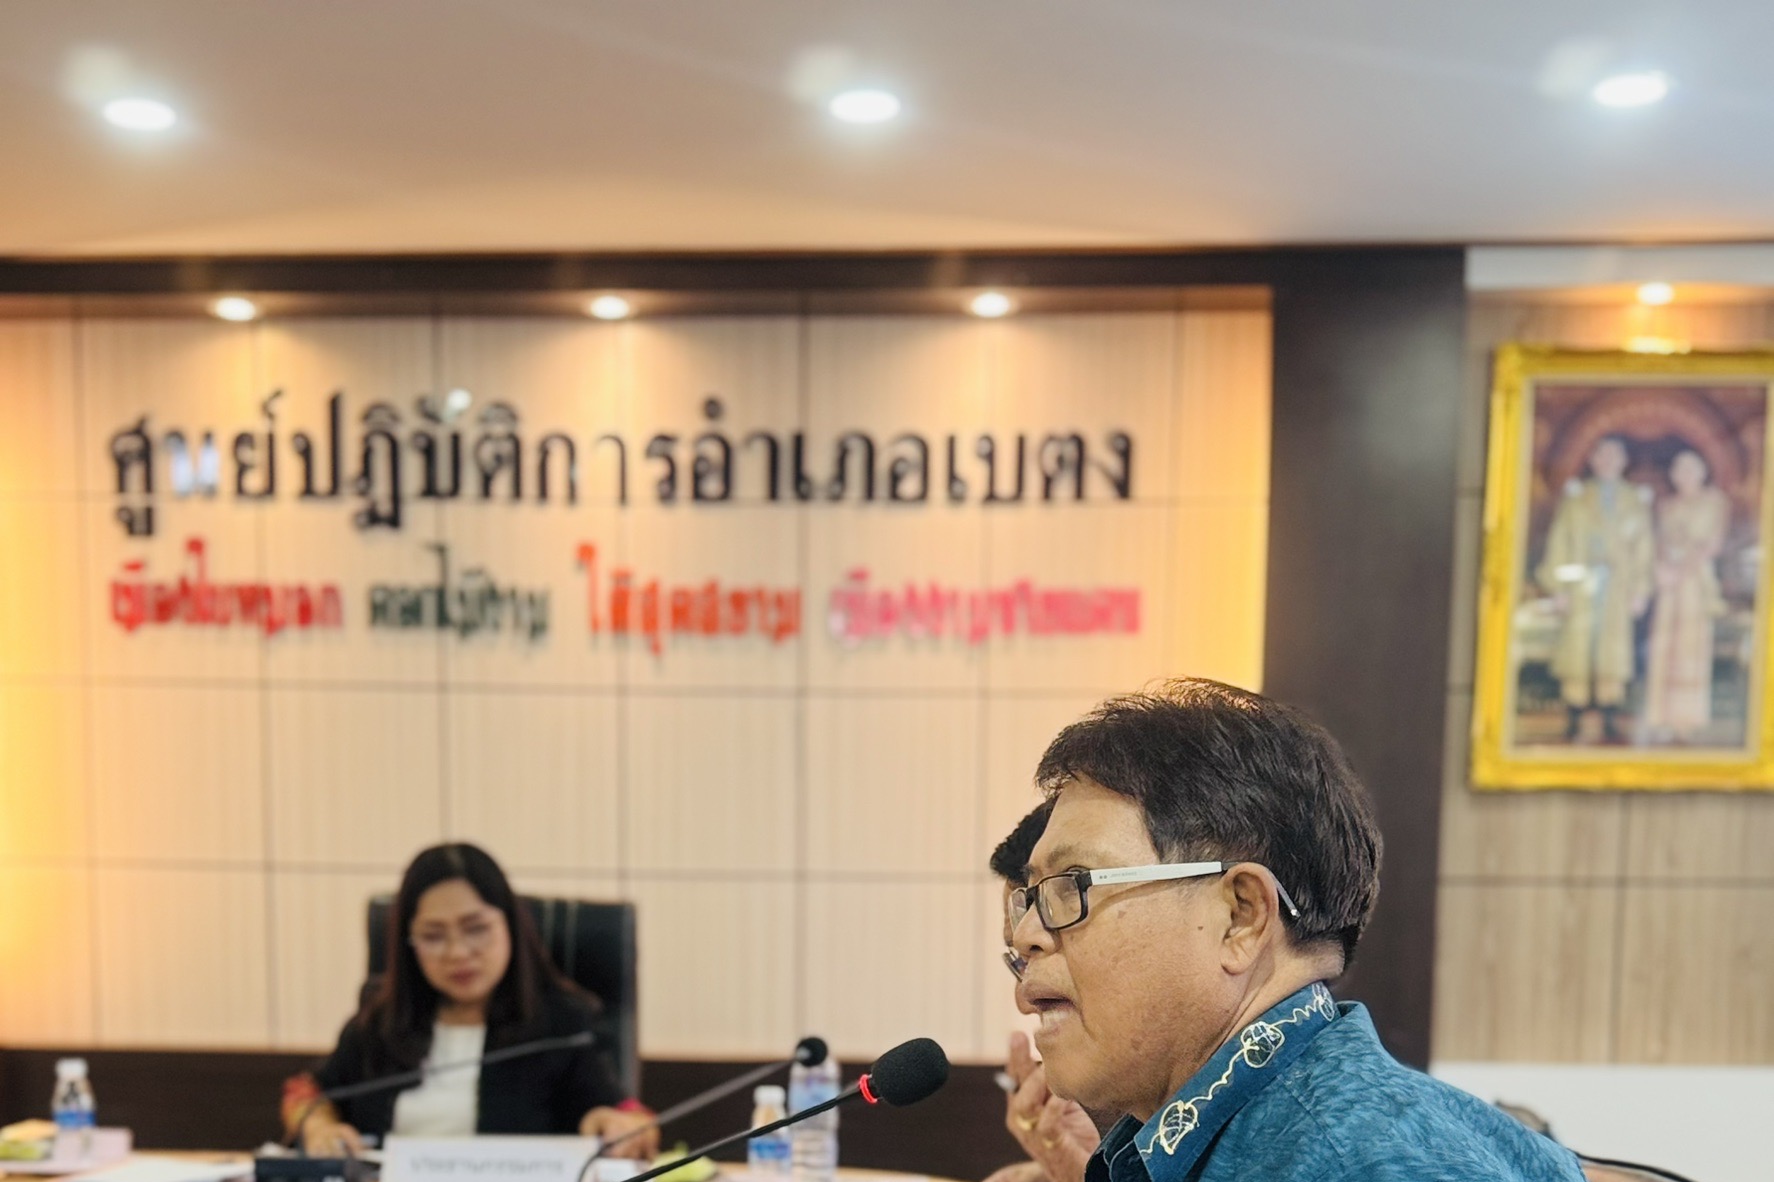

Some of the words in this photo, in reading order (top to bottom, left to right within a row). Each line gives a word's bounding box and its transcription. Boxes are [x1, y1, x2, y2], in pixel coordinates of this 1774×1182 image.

[110, 388, 1134, 537] ศูนย์ปฏิบัติการอำเภอเบตง
